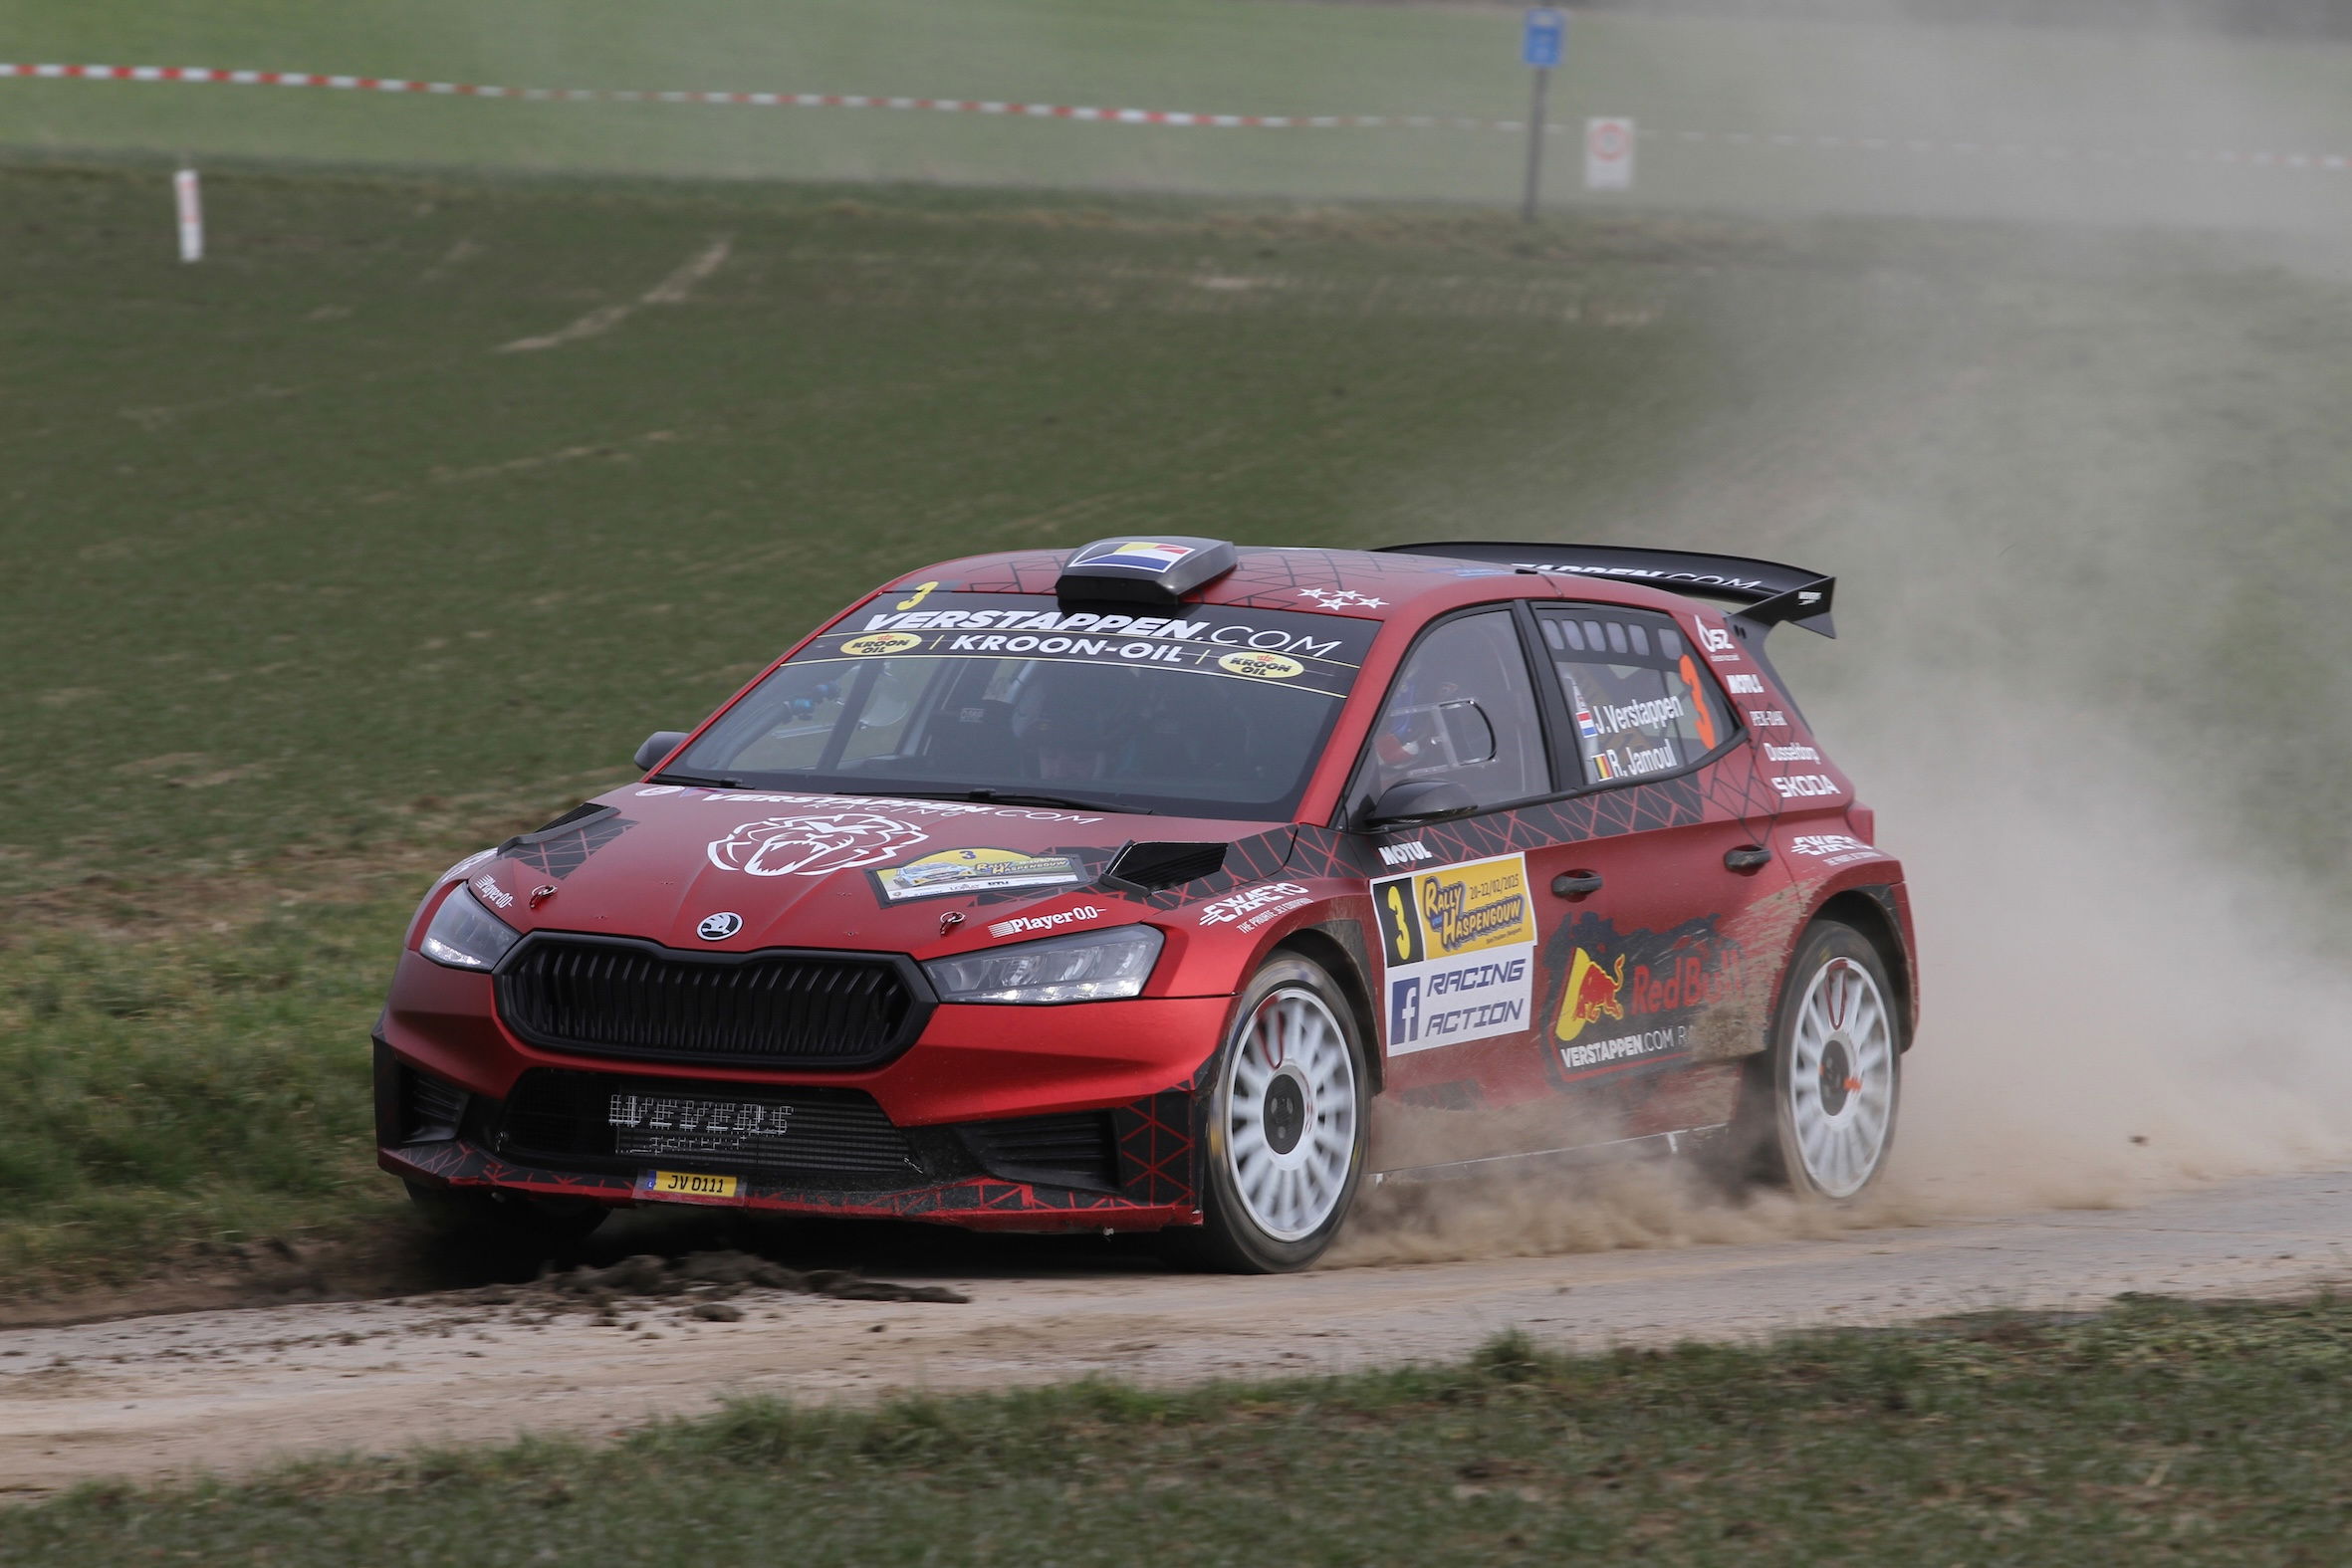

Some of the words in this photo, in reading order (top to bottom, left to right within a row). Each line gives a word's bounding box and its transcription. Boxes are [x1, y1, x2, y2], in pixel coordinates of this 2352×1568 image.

[896, 580, 939, 611] 3
[851, 638, 910, 649] KROON
[863, 609, 1343, 658] VERSTAPPEN.COM
[949, 634, 1185, 663] KROON-OIL
[861, 646, 885, 655] OIL
[1229, 656, 1293, 673] KROON
[1241, 664, 1267, 676] OIL
[1679, 654, 1717, 751] 3
[1606, 748, 1629, 778] R.
[1626, 738, 1678, 776] Jamoul
[1770, 774, 1841, 798] SKODA
[702, 793, 1104, 825] VERSTAPPEN.COM
[959, 850, 977, 860] 3
[1378, 840, 1433, 866] MOTUL
[1425, 878, 1464, 919] RALLY
[1009, 911, 1073, 933] Player
[1236, 921, 1256, 934] THE
[1387, 885, 1411, 961] 3
[1443, 899, 1523, 946] HASPENGOUW
[1426, 958, 1527, 998] RACING
[1425, 998, 1525, 1037] ACTION
[1560, 1028, 1675, 1068] VERSTAPPEN.COM
[668, 1175, 689, 1191] JV
